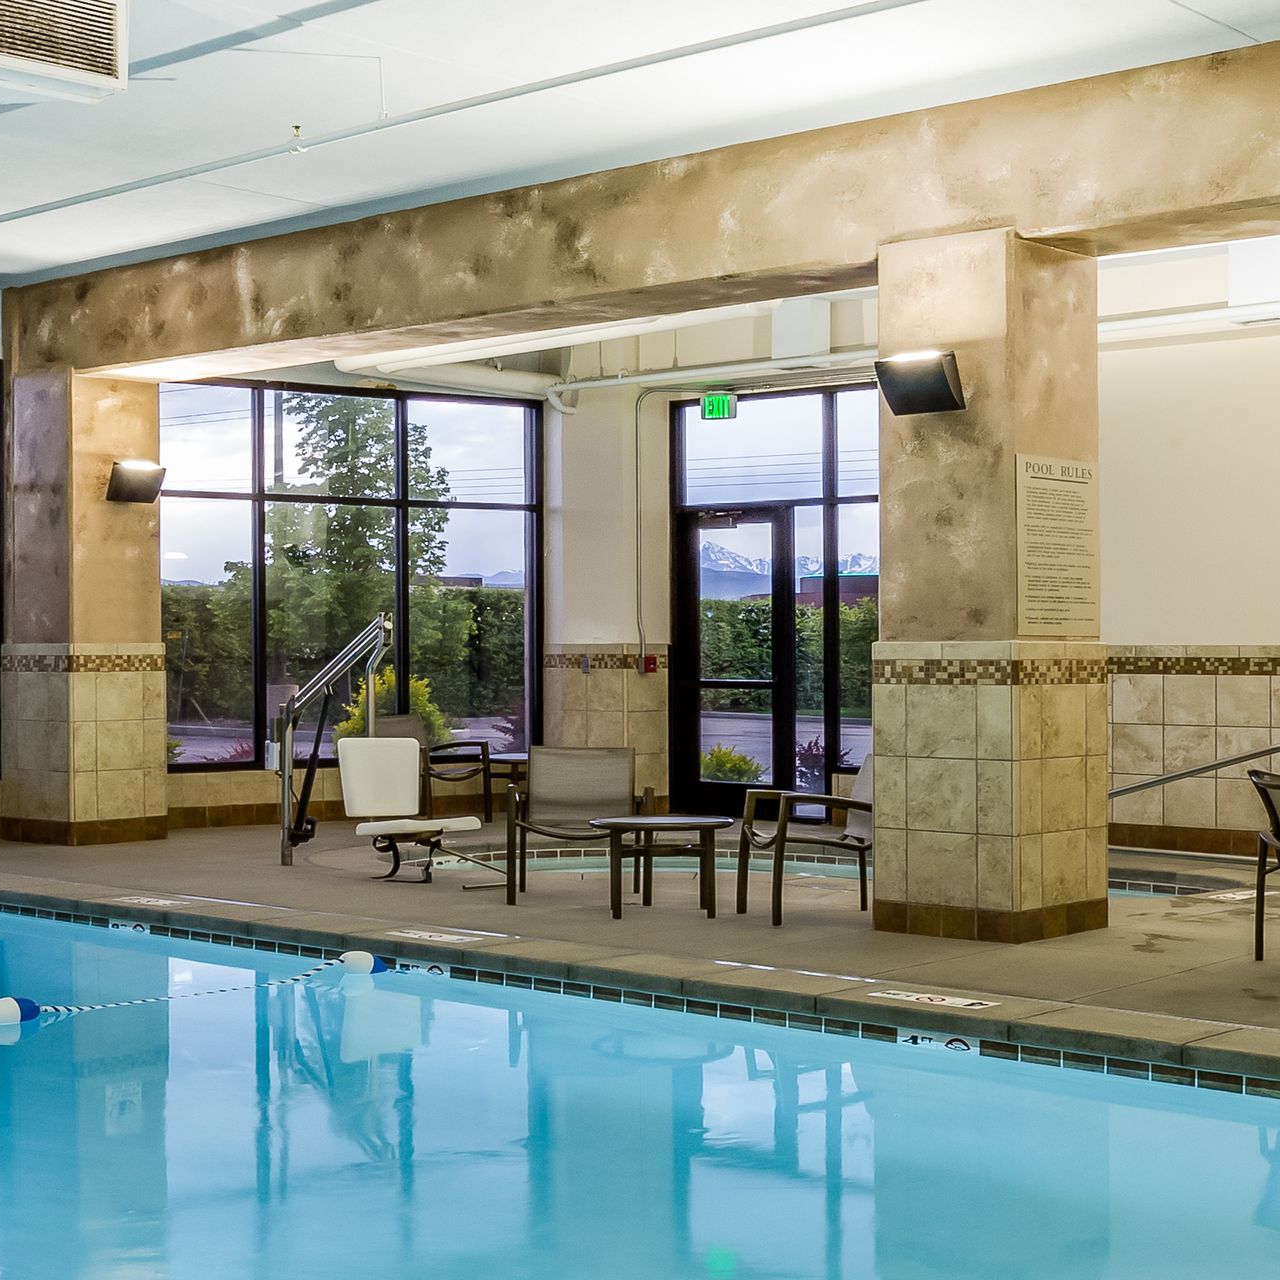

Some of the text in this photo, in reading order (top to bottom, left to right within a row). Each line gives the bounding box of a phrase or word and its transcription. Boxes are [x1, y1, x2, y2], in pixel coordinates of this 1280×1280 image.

[704, 395, 730, 418] EXIT
[1025, 461, 1093, 480] POOL RULES
